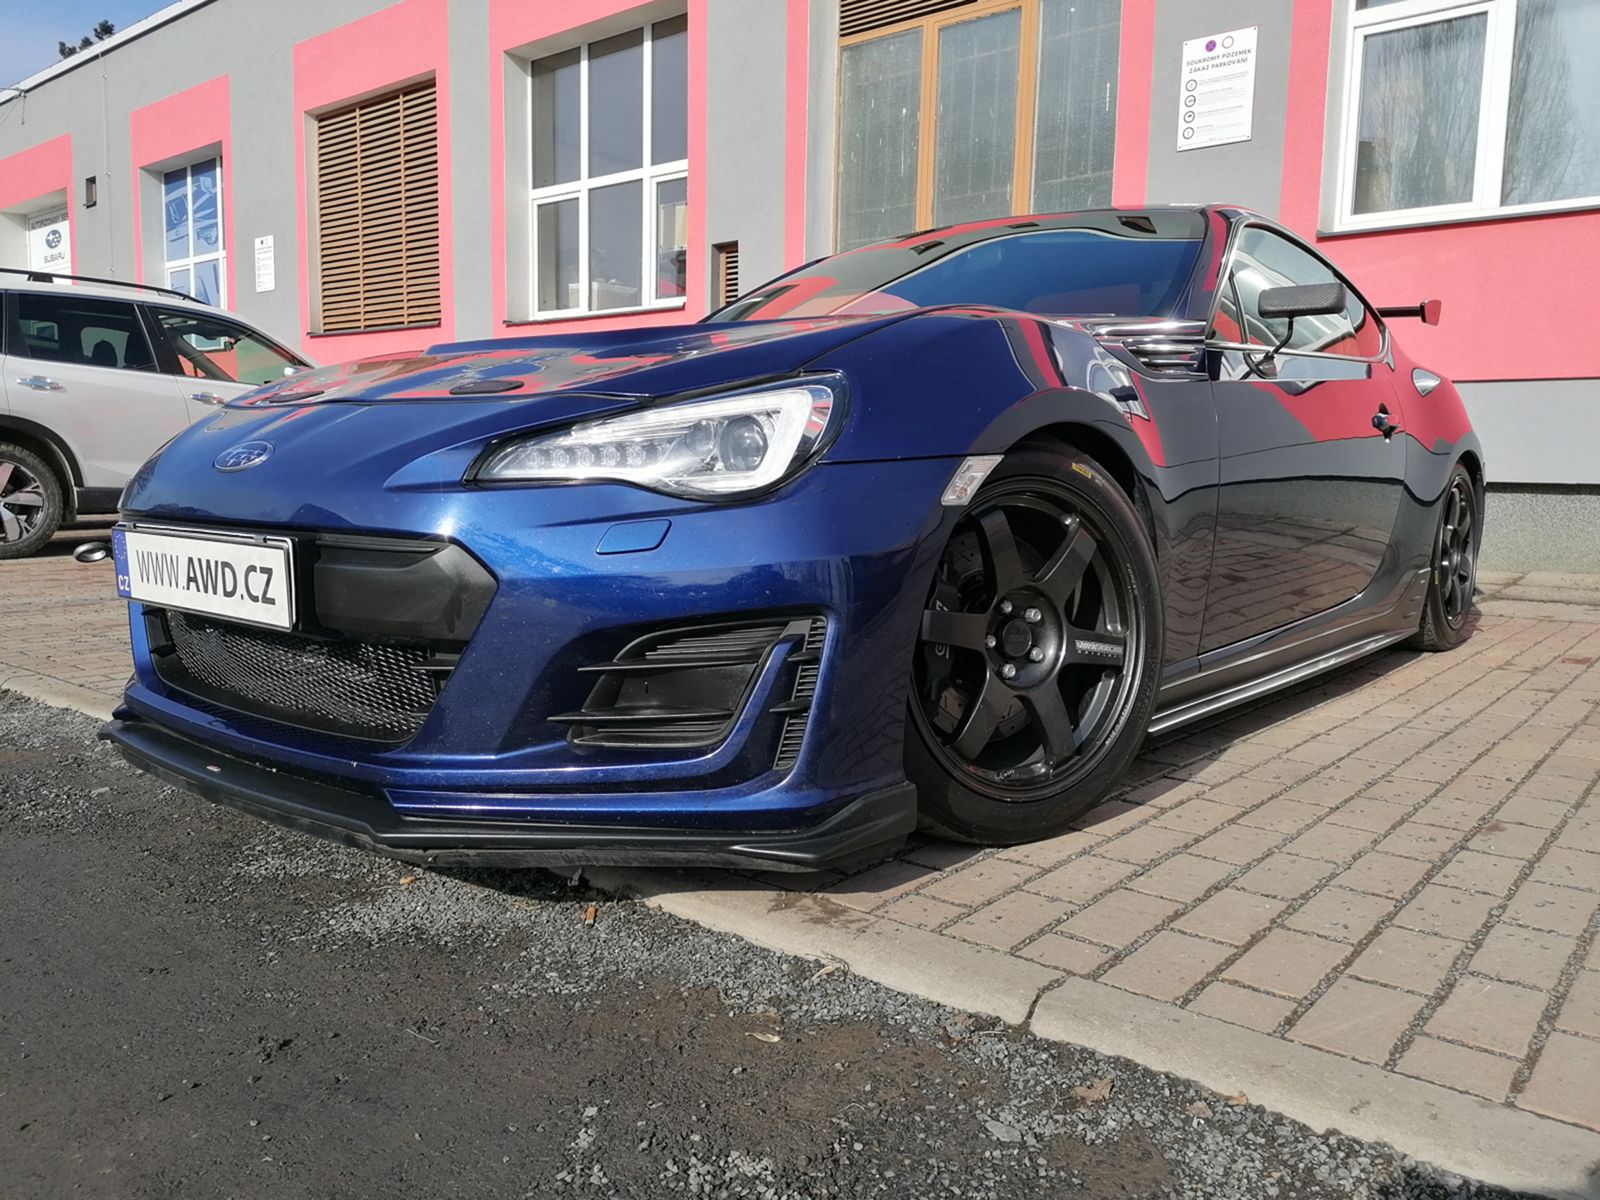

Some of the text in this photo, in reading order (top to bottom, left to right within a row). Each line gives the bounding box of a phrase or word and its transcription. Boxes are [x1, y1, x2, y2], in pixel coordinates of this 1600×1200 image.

[44, 252, 65, 264] SUBARU
[118, 574, 130, 591] CZ
[136, 549, 276, 606] WWW.AWD.CZ
